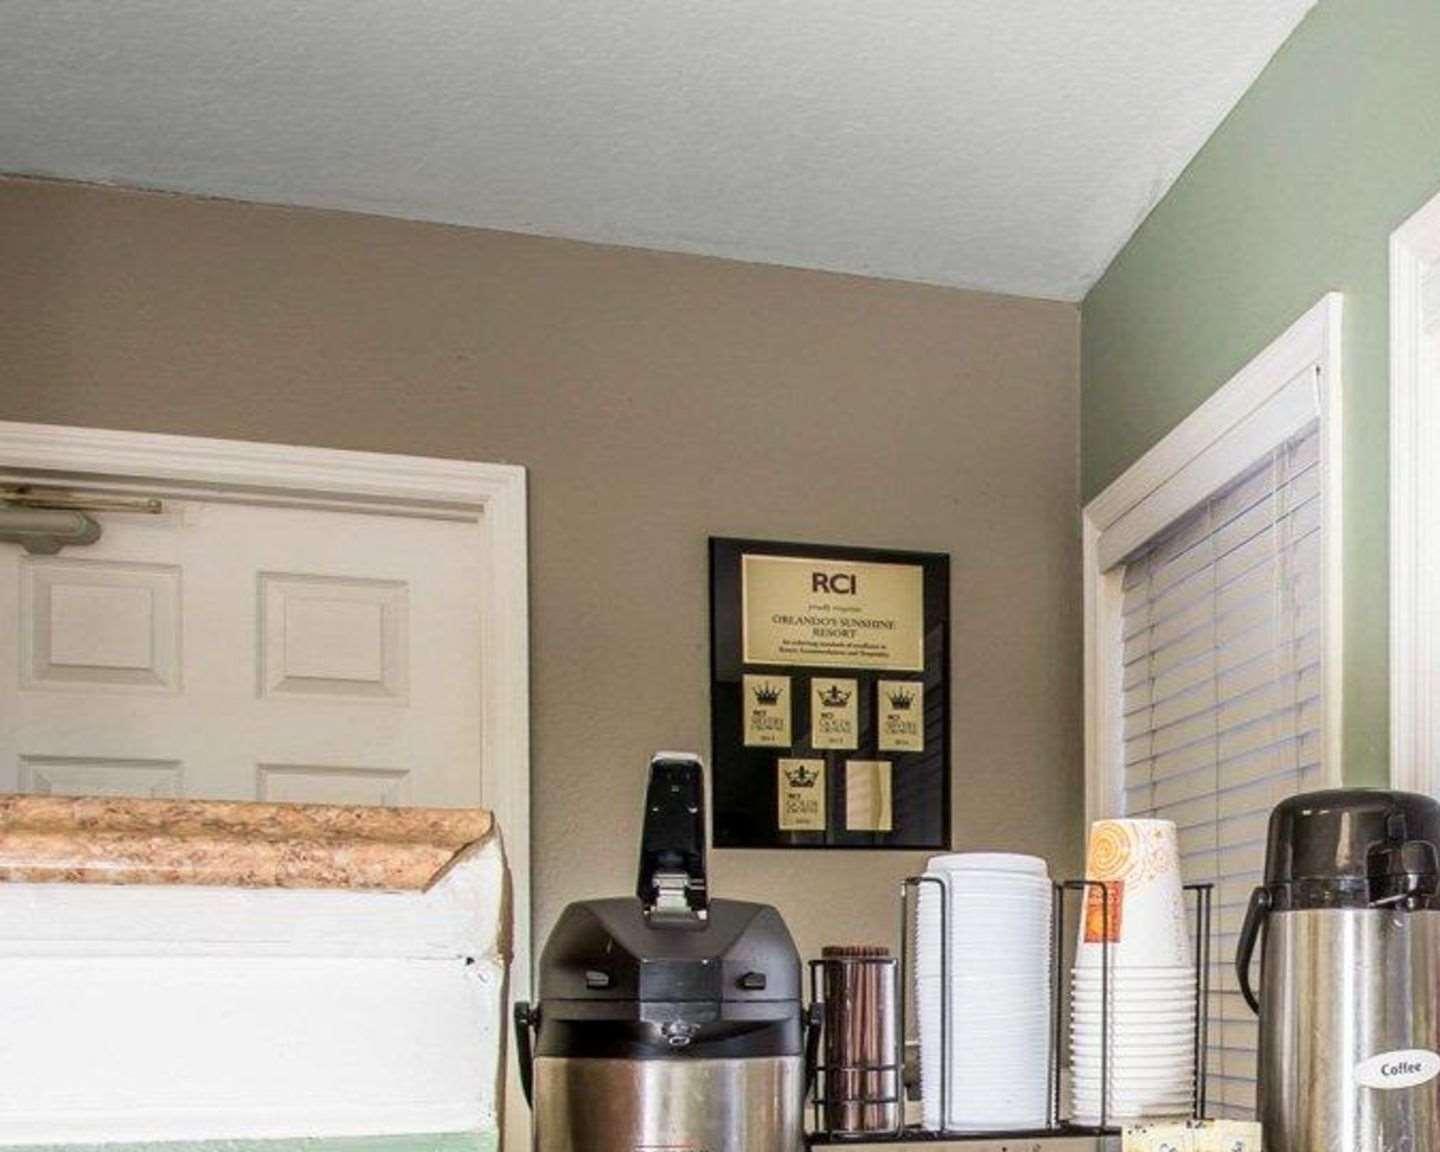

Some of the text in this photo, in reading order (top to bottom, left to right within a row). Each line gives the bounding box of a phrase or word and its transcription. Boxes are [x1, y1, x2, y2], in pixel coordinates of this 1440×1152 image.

[812, 572, 856, 595] RCI
[840, 616, 895, 630] SUNSHINE
[813, 627, 857, 639] RESORT
[1381, 1062, 1422, 1076] Coffee
